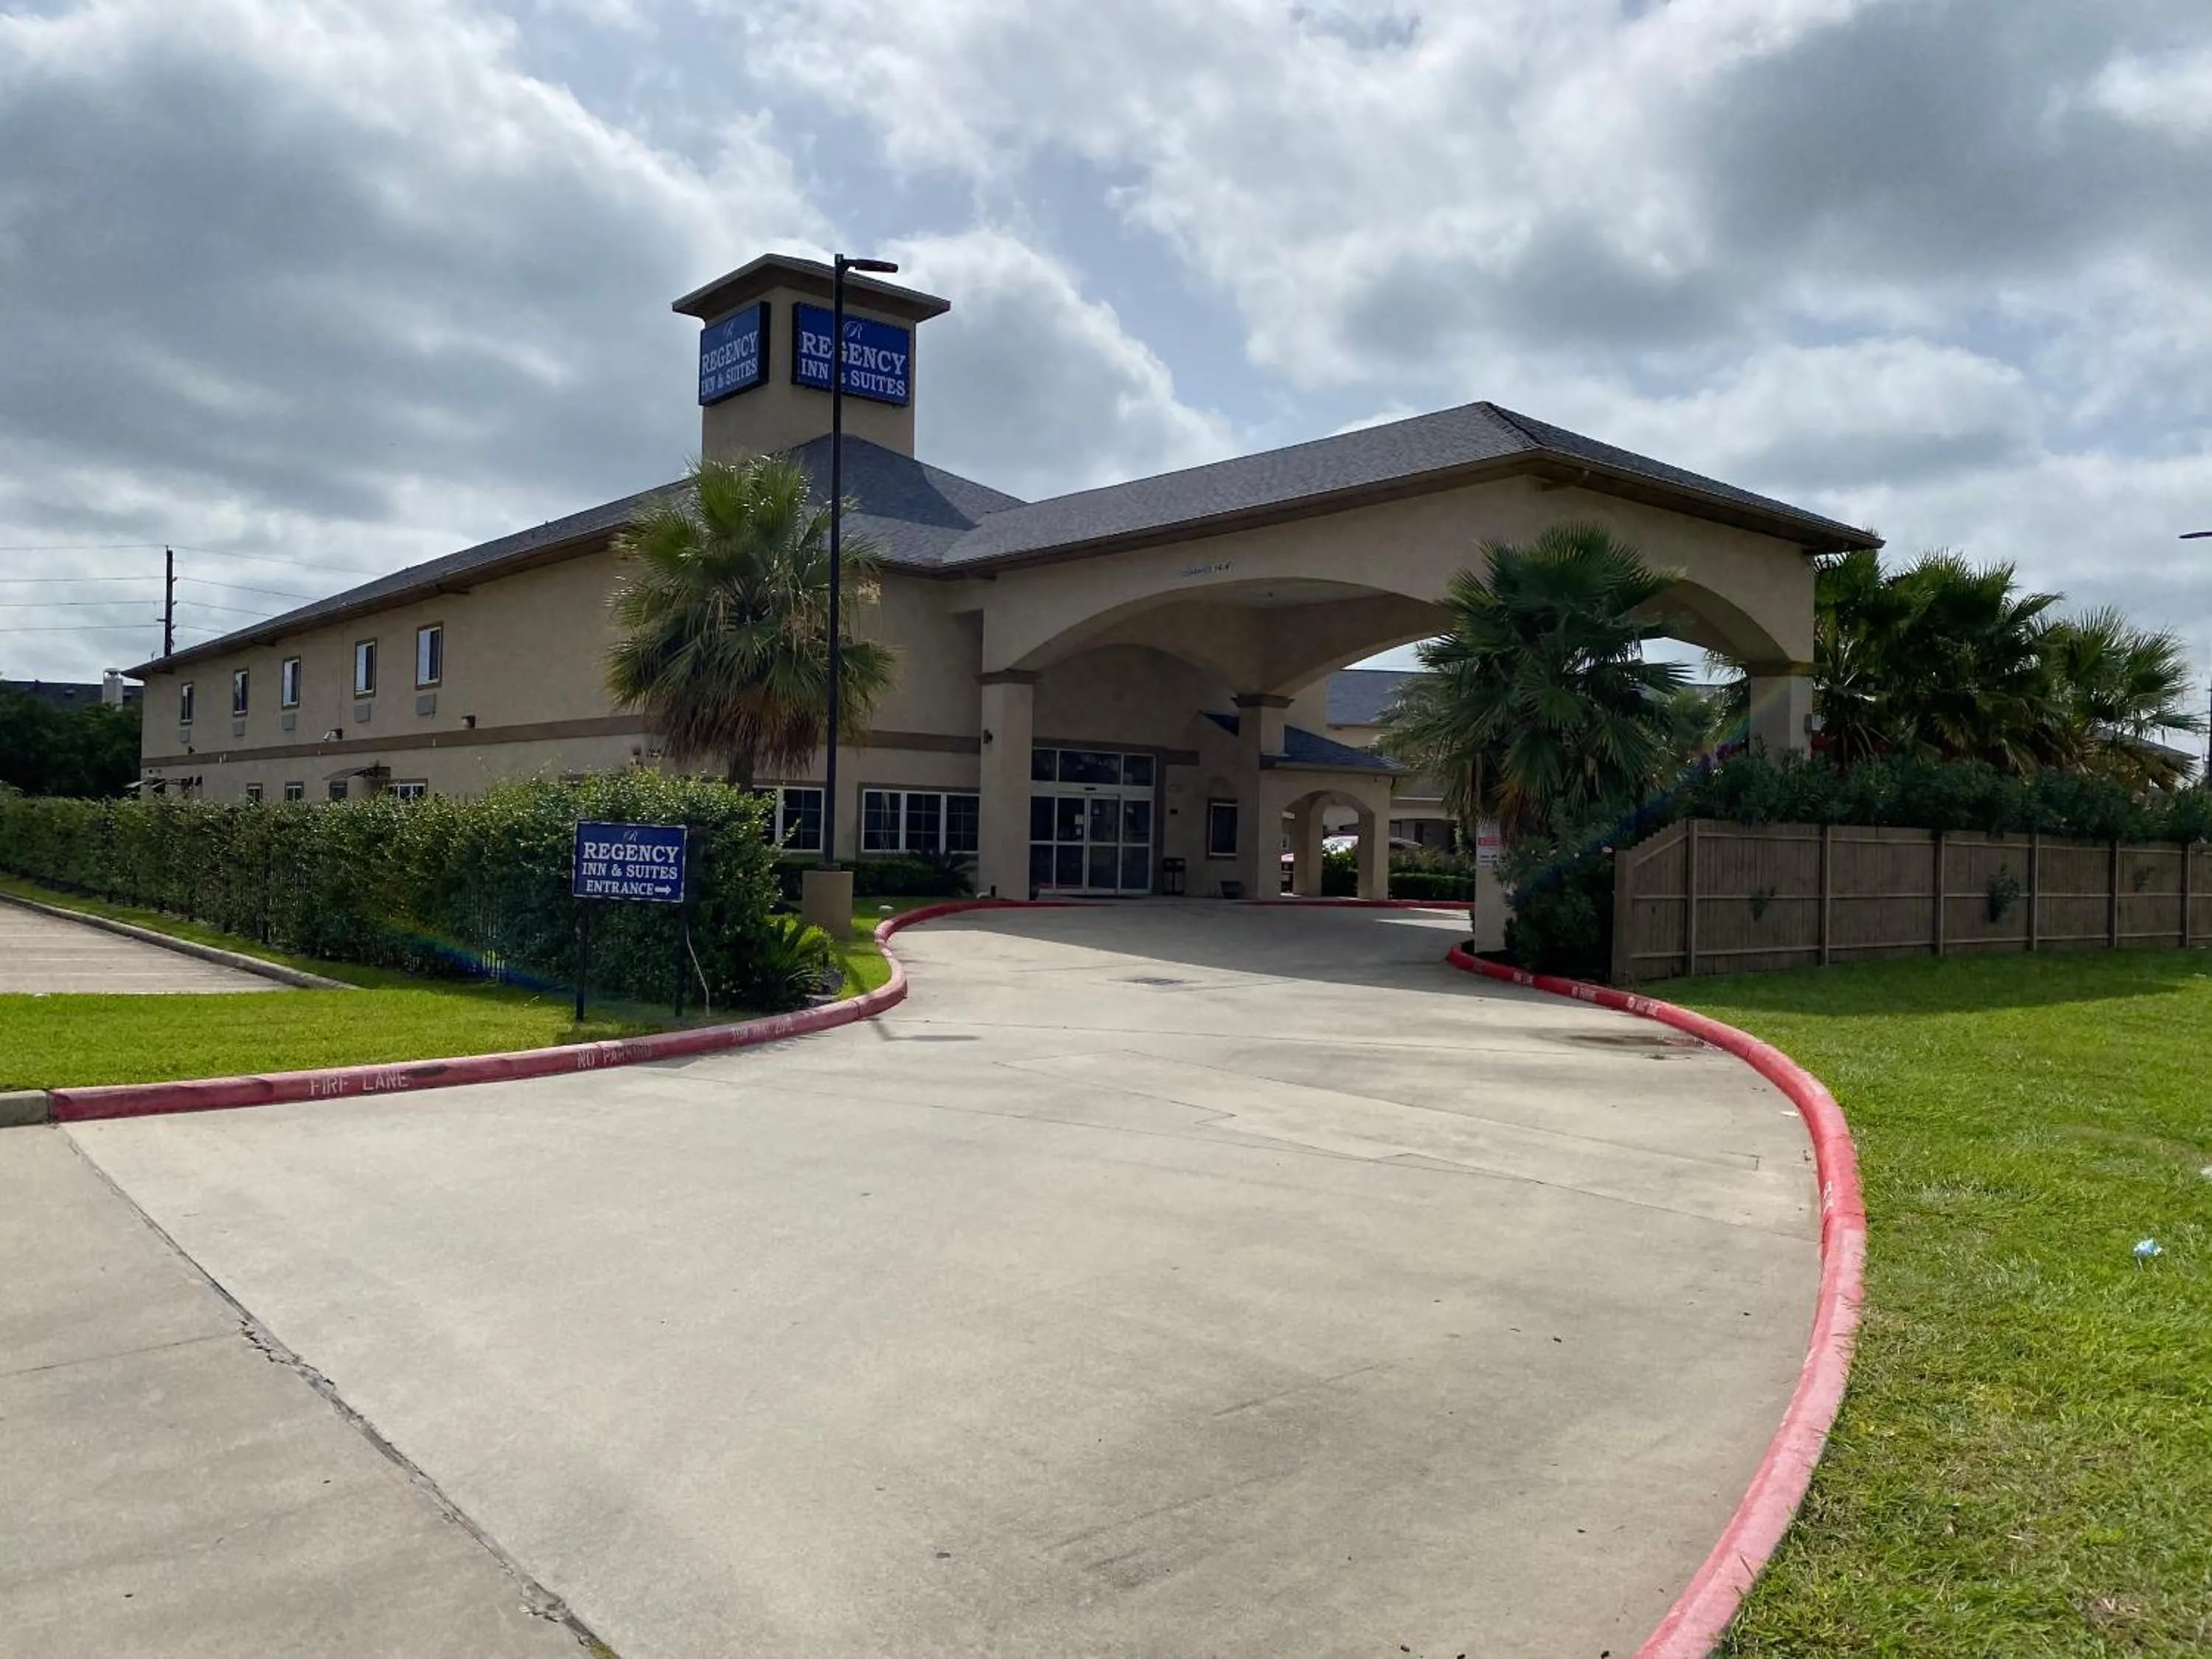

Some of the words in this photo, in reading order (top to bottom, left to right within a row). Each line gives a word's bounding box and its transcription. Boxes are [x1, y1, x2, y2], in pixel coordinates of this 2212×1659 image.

[702, 330, 758, 375] REGENCY
[701, 376, 716, 395] INN
[725, 358, 757, 386] SUITES
[801, 358, 830, 380] INN
[850, 369, 905, 397] SUITES
[583, 842, 679, 863] REGENCY
[582, 862, 607, 876] INN
[611, 863, 622, 877] &
[627, 865, 678, 880] SUITES
[586, 880, 654, 896] ENTRANCE
[577, 1049, 595, 1068] NO
[362, 1071, 408, 1091] LANE
